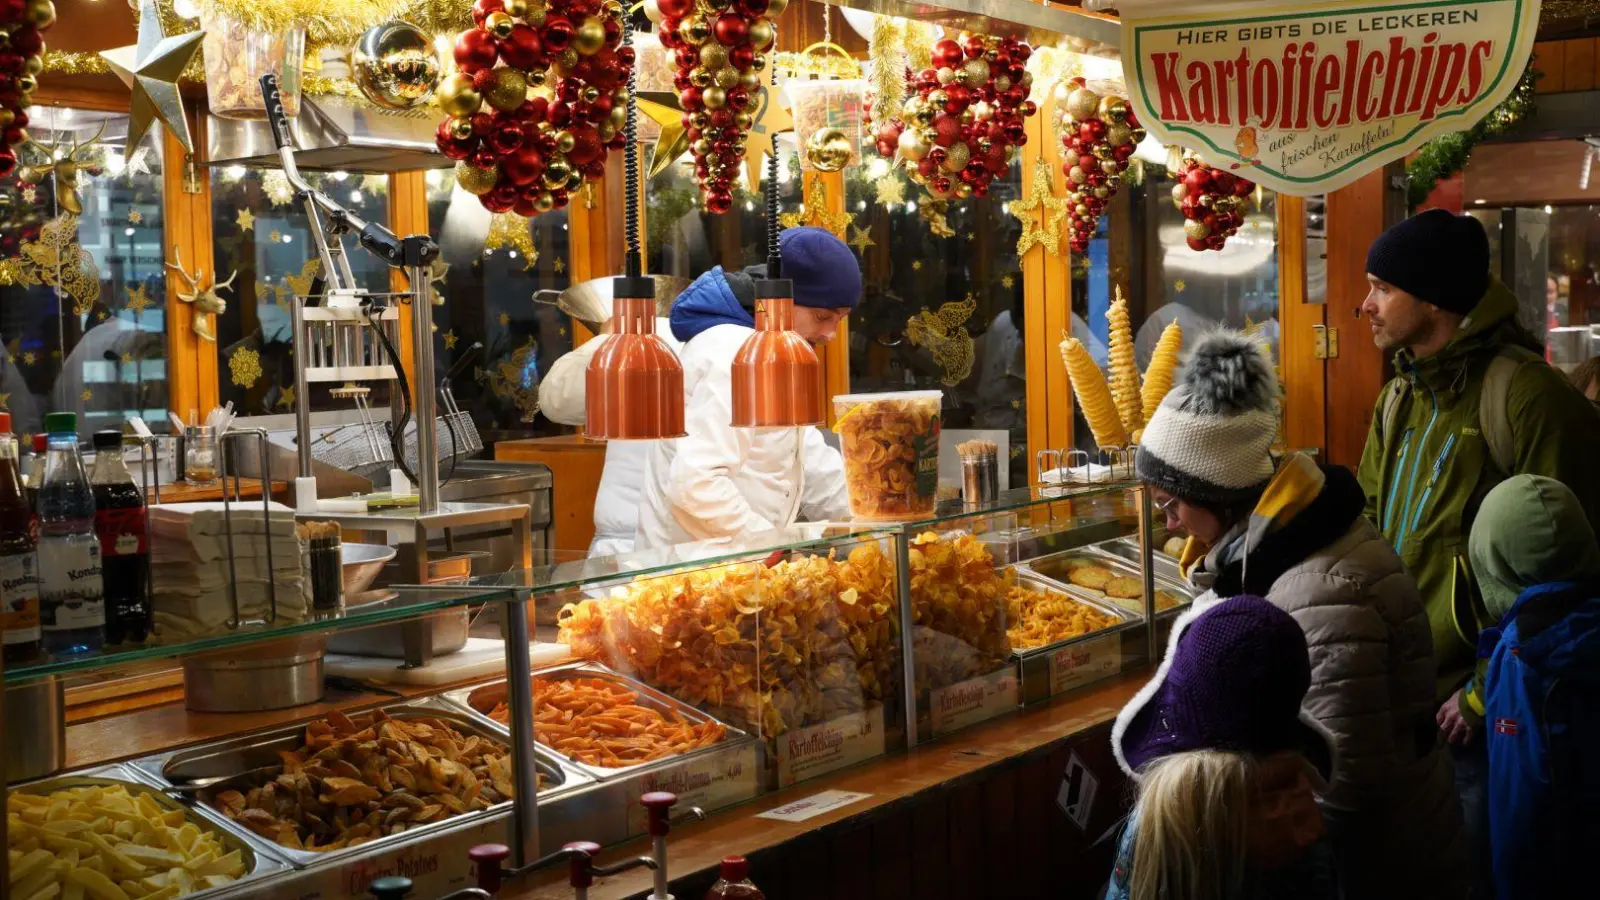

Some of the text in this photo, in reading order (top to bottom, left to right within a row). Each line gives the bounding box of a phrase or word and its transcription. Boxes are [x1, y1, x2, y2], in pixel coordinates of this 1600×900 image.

[1177, 8, 1479, 46] HIER GIBTS DIE LECKEREN
[1150, 31, 1493, 130] Kartoffelchips
[1268, 133, 1296, 153] aus
[1280, 131, 1340, 176] frischen
[1318, 119, 1396, 169] Kartoffeln!
